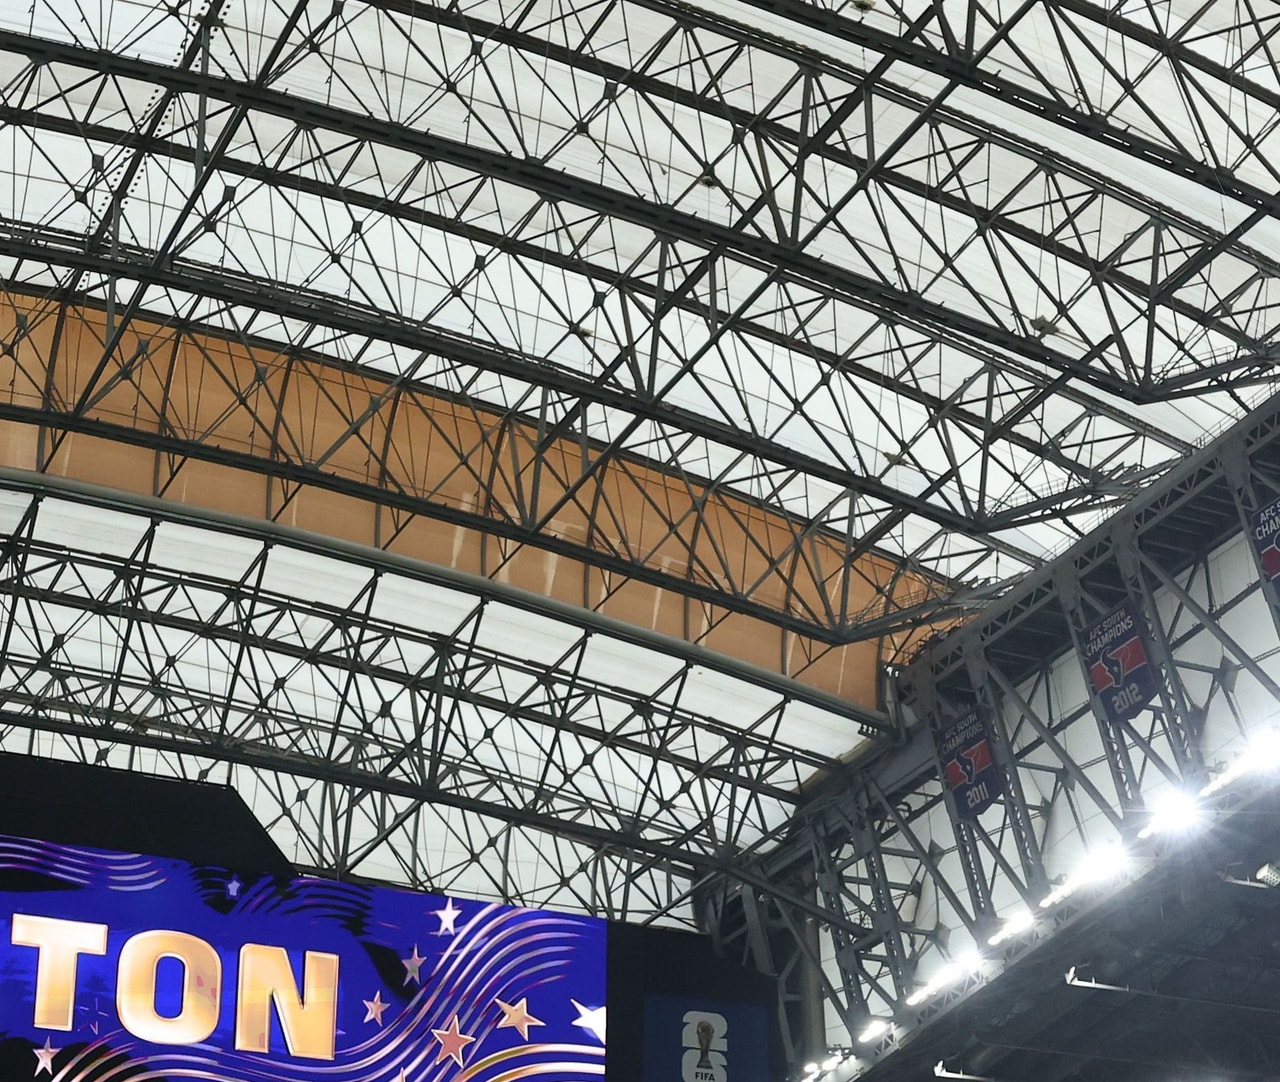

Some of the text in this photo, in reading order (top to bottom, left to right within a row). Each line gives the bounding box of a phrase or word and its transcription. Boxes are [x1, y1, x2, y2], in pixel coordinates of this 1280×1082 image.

[1260, 506, 1276, 523] AFC
[1102, 608, 1125, 630] SOUTH
[1086, 616, 1133, 656] CHAMPIONS
[1112, 682, 1143, 713] 2012
[966, 782, 989, 808] 2011
[695, 1072, 716, 1082] FIFA
